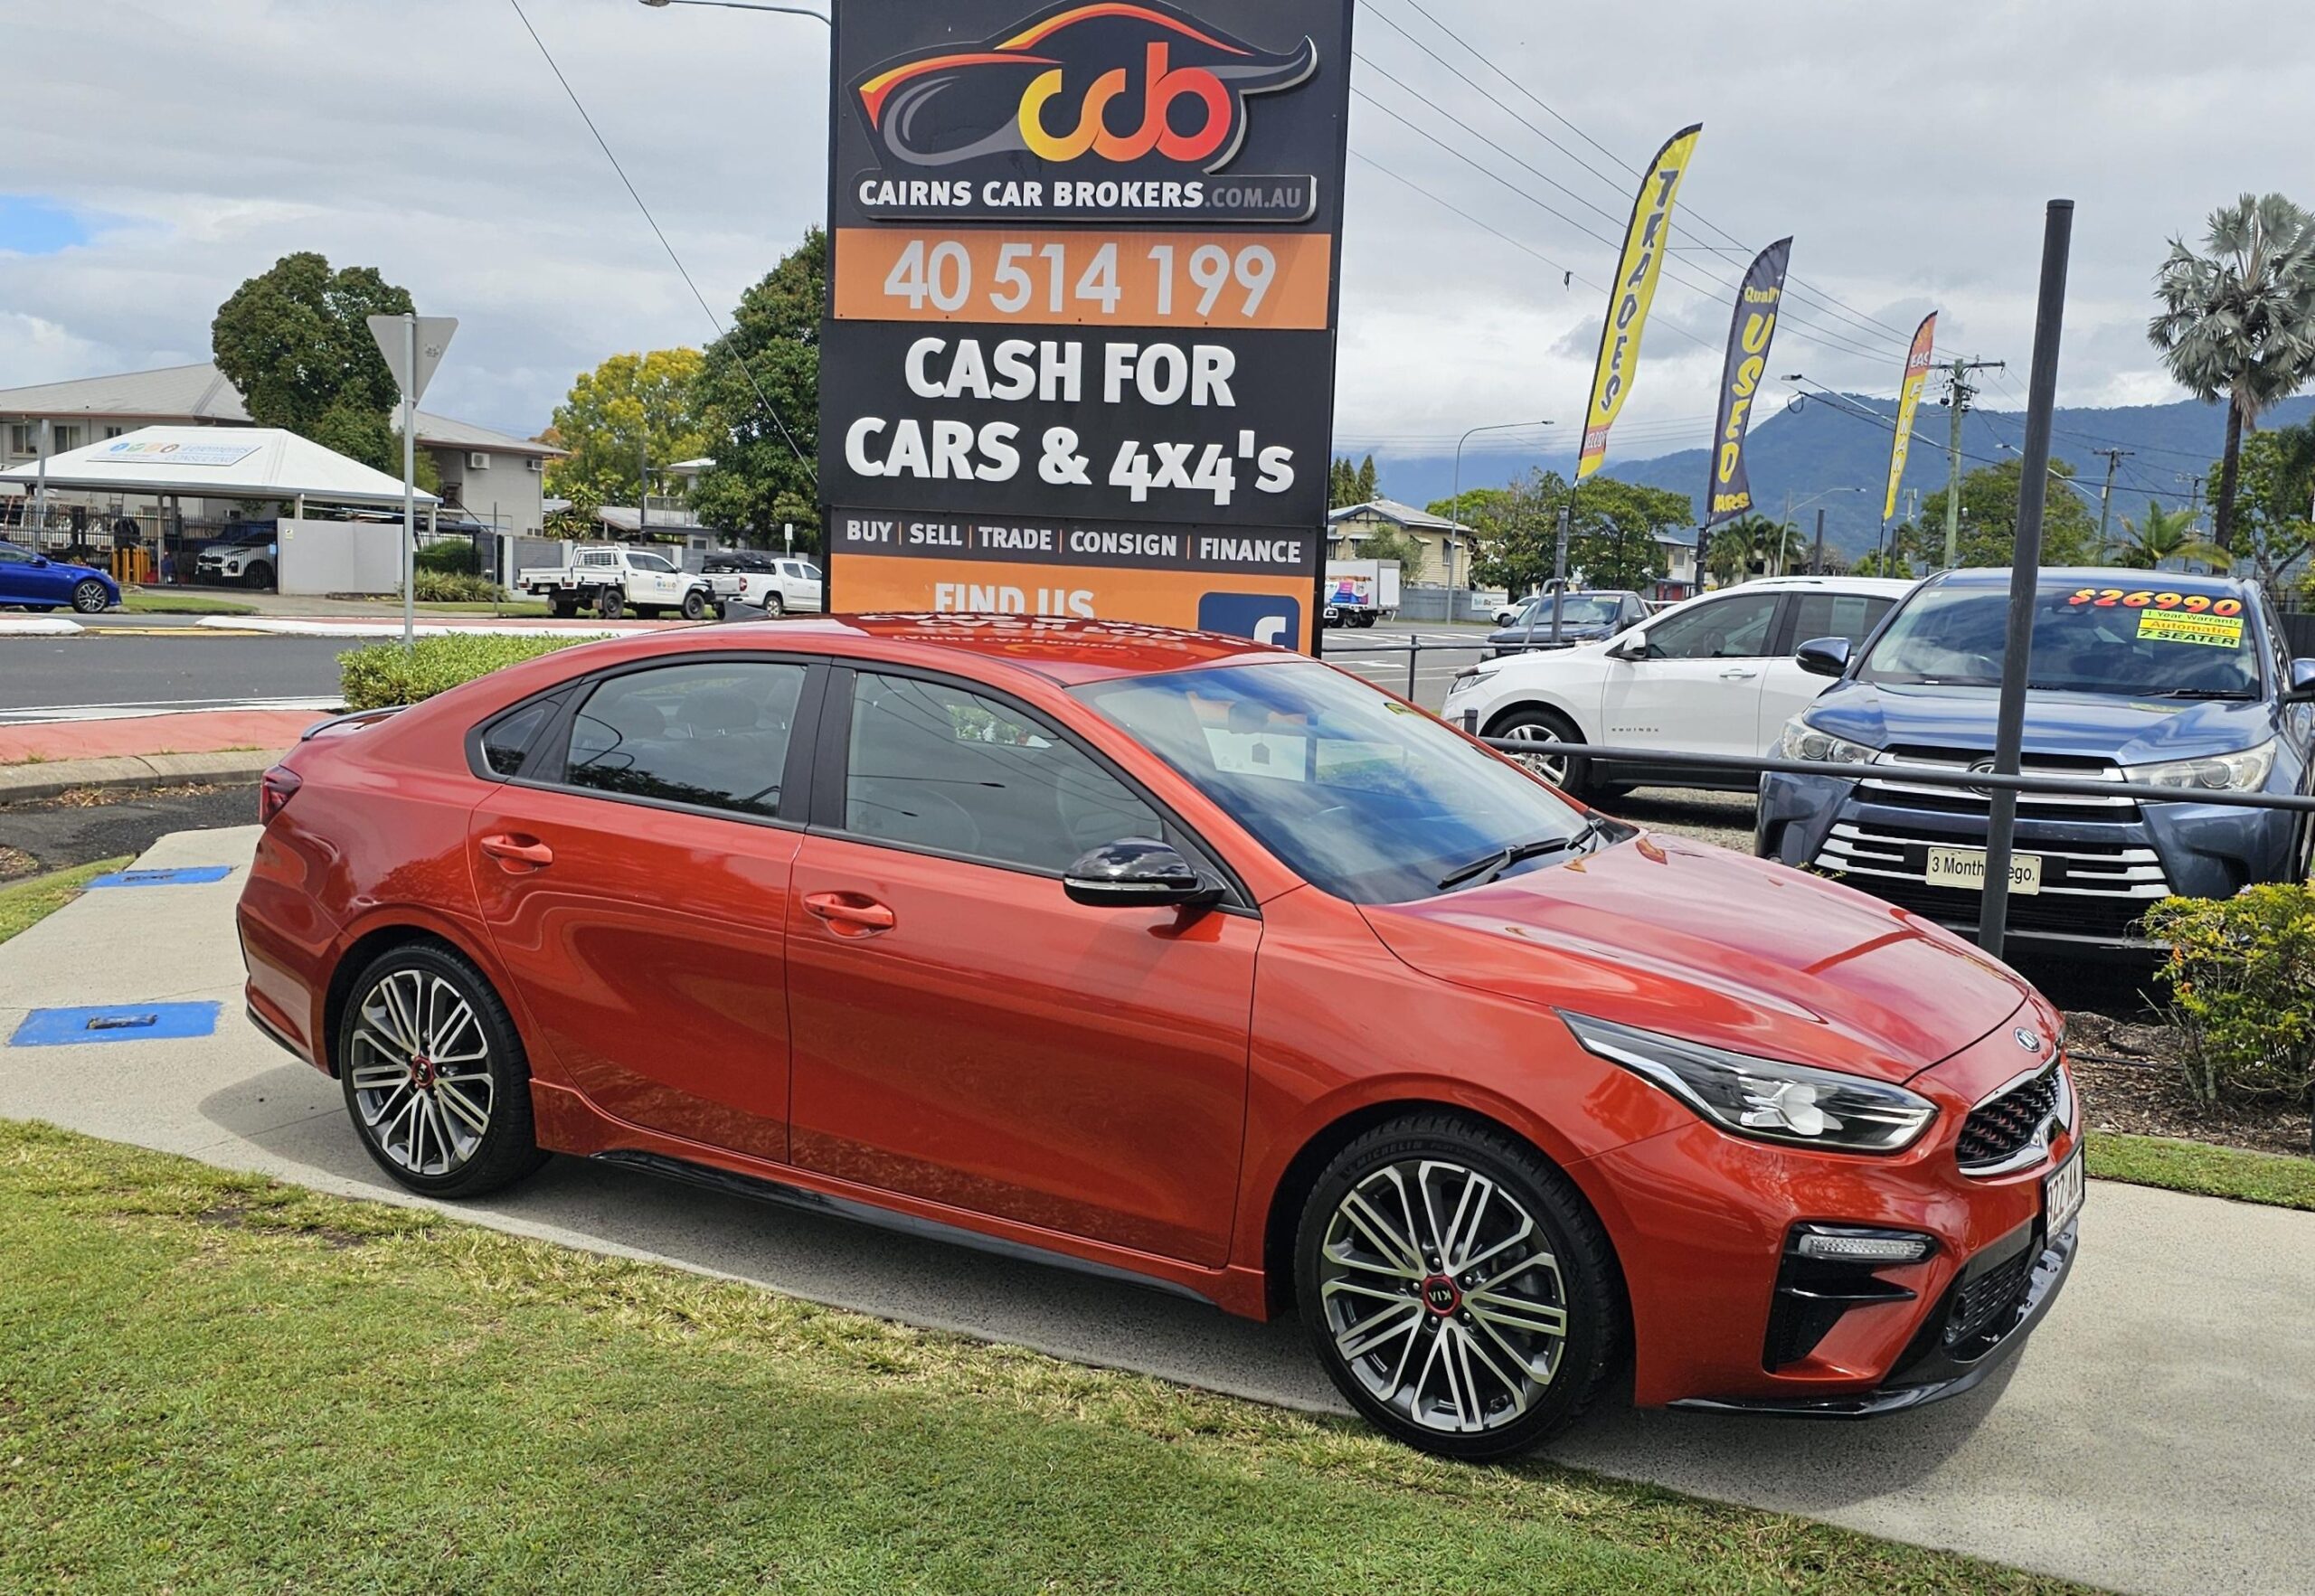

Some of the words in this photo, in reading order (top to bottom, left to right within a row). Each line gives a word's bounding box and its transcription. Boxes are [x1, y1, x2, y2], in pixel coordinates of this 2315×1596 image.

[859, 181, 972, 207] CAIRNS
[982, 182, 1042, 208] CAR
[883, 240, 971, 310] 40
[989, 242, 1121, 315] 514
[1147, 244, 1276, 317] 199
[905, 337, 1082, 402] CASH
[1103, 342, 1236, 407] FOR
[1718, 312, 1775, 484] USED
[845, 417, 1021, 482] CARS
[1038, 426, 1091, 486] &
[846, 520, 893, 543] BUY
[910, 524, 963, 547] SELL
[978, 526, 1053, 551] TRADE
[1070, 530, 1177, 557] CONSIGN
[1199, 536, 1301, 564] FINANCE
[935, 582, 1025, 614] FIND
[2068, 588, 2242, 616] $26990
[2150, 620, 2231, 636] Automatic
[2158, 611, 2183, 620] Year
[2187, 614, 2239, 627] Warranty
[2140, 629, 2151, 637] 7
[2158, 631, 2235, 646] SEATER
[1932, 856, 1940, 874] 3
[1943, 856, 1985, 877] Month
[2008, 865, 2036, 884] ego.
